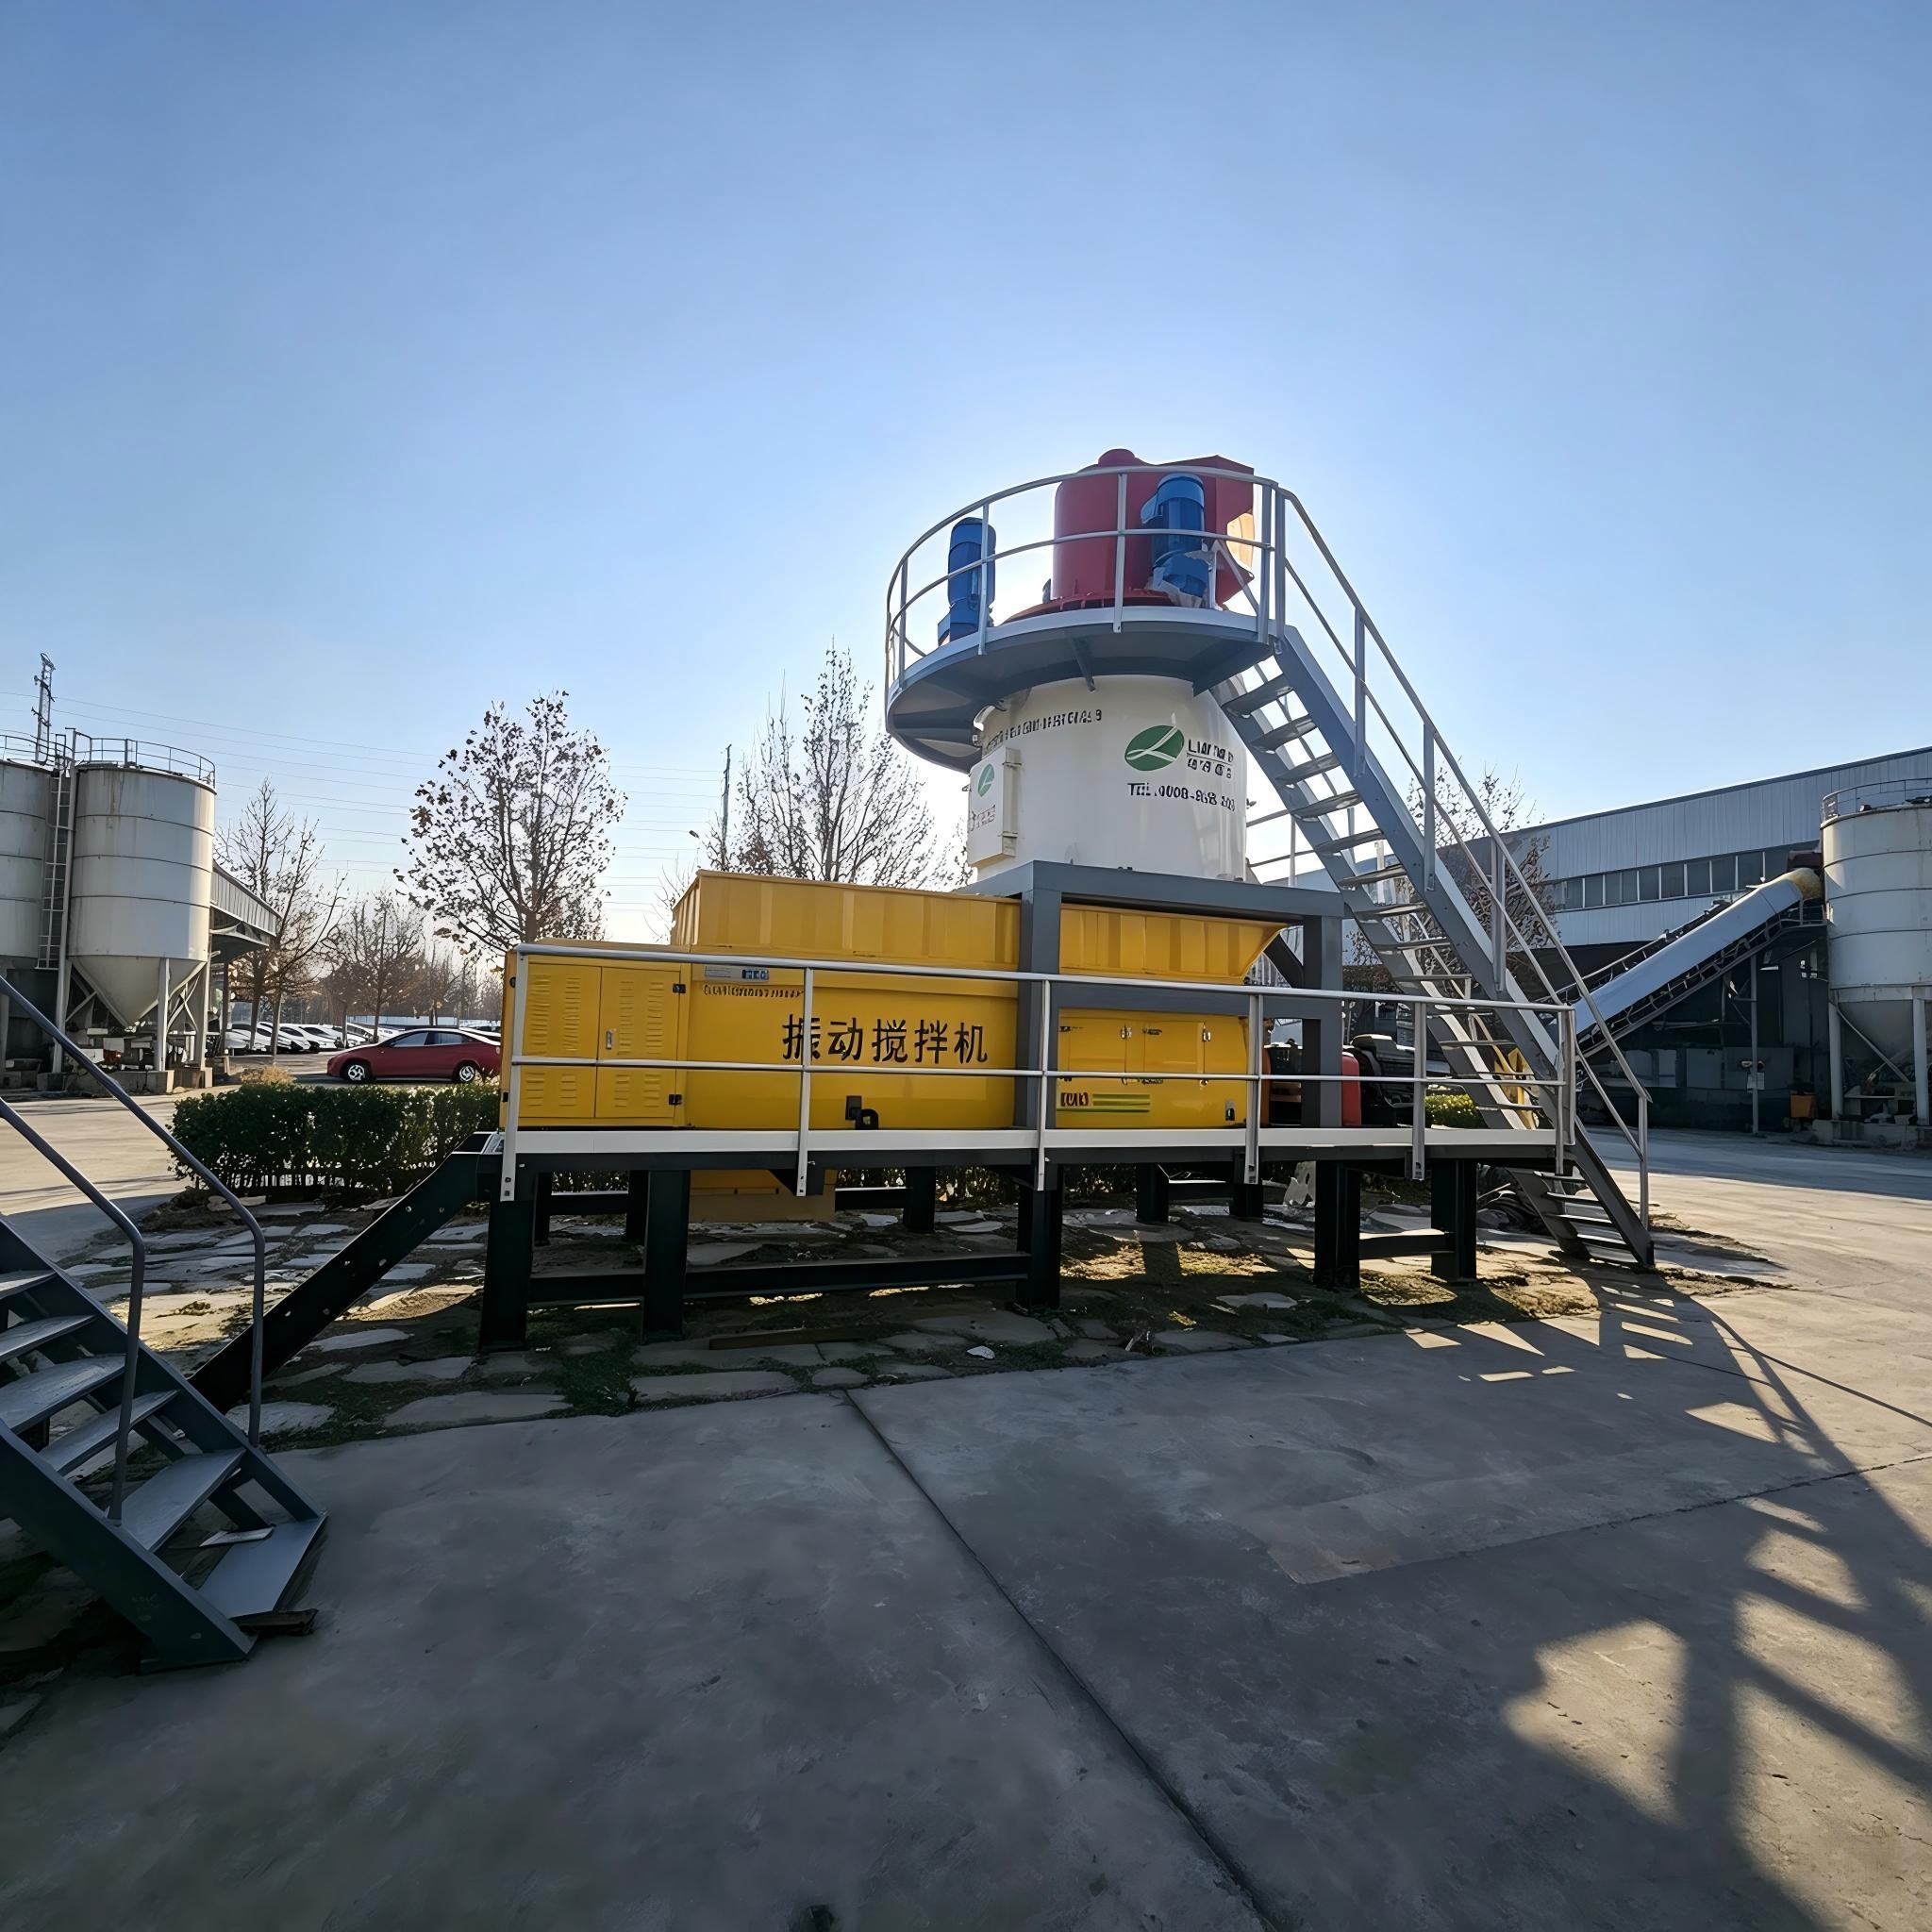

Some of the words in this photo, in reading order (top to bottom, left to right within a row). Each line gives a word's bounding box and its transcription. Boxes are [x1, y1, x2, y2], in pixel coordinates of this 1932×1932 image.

[782, 1014, 988, 1064] 振动搅拌机
